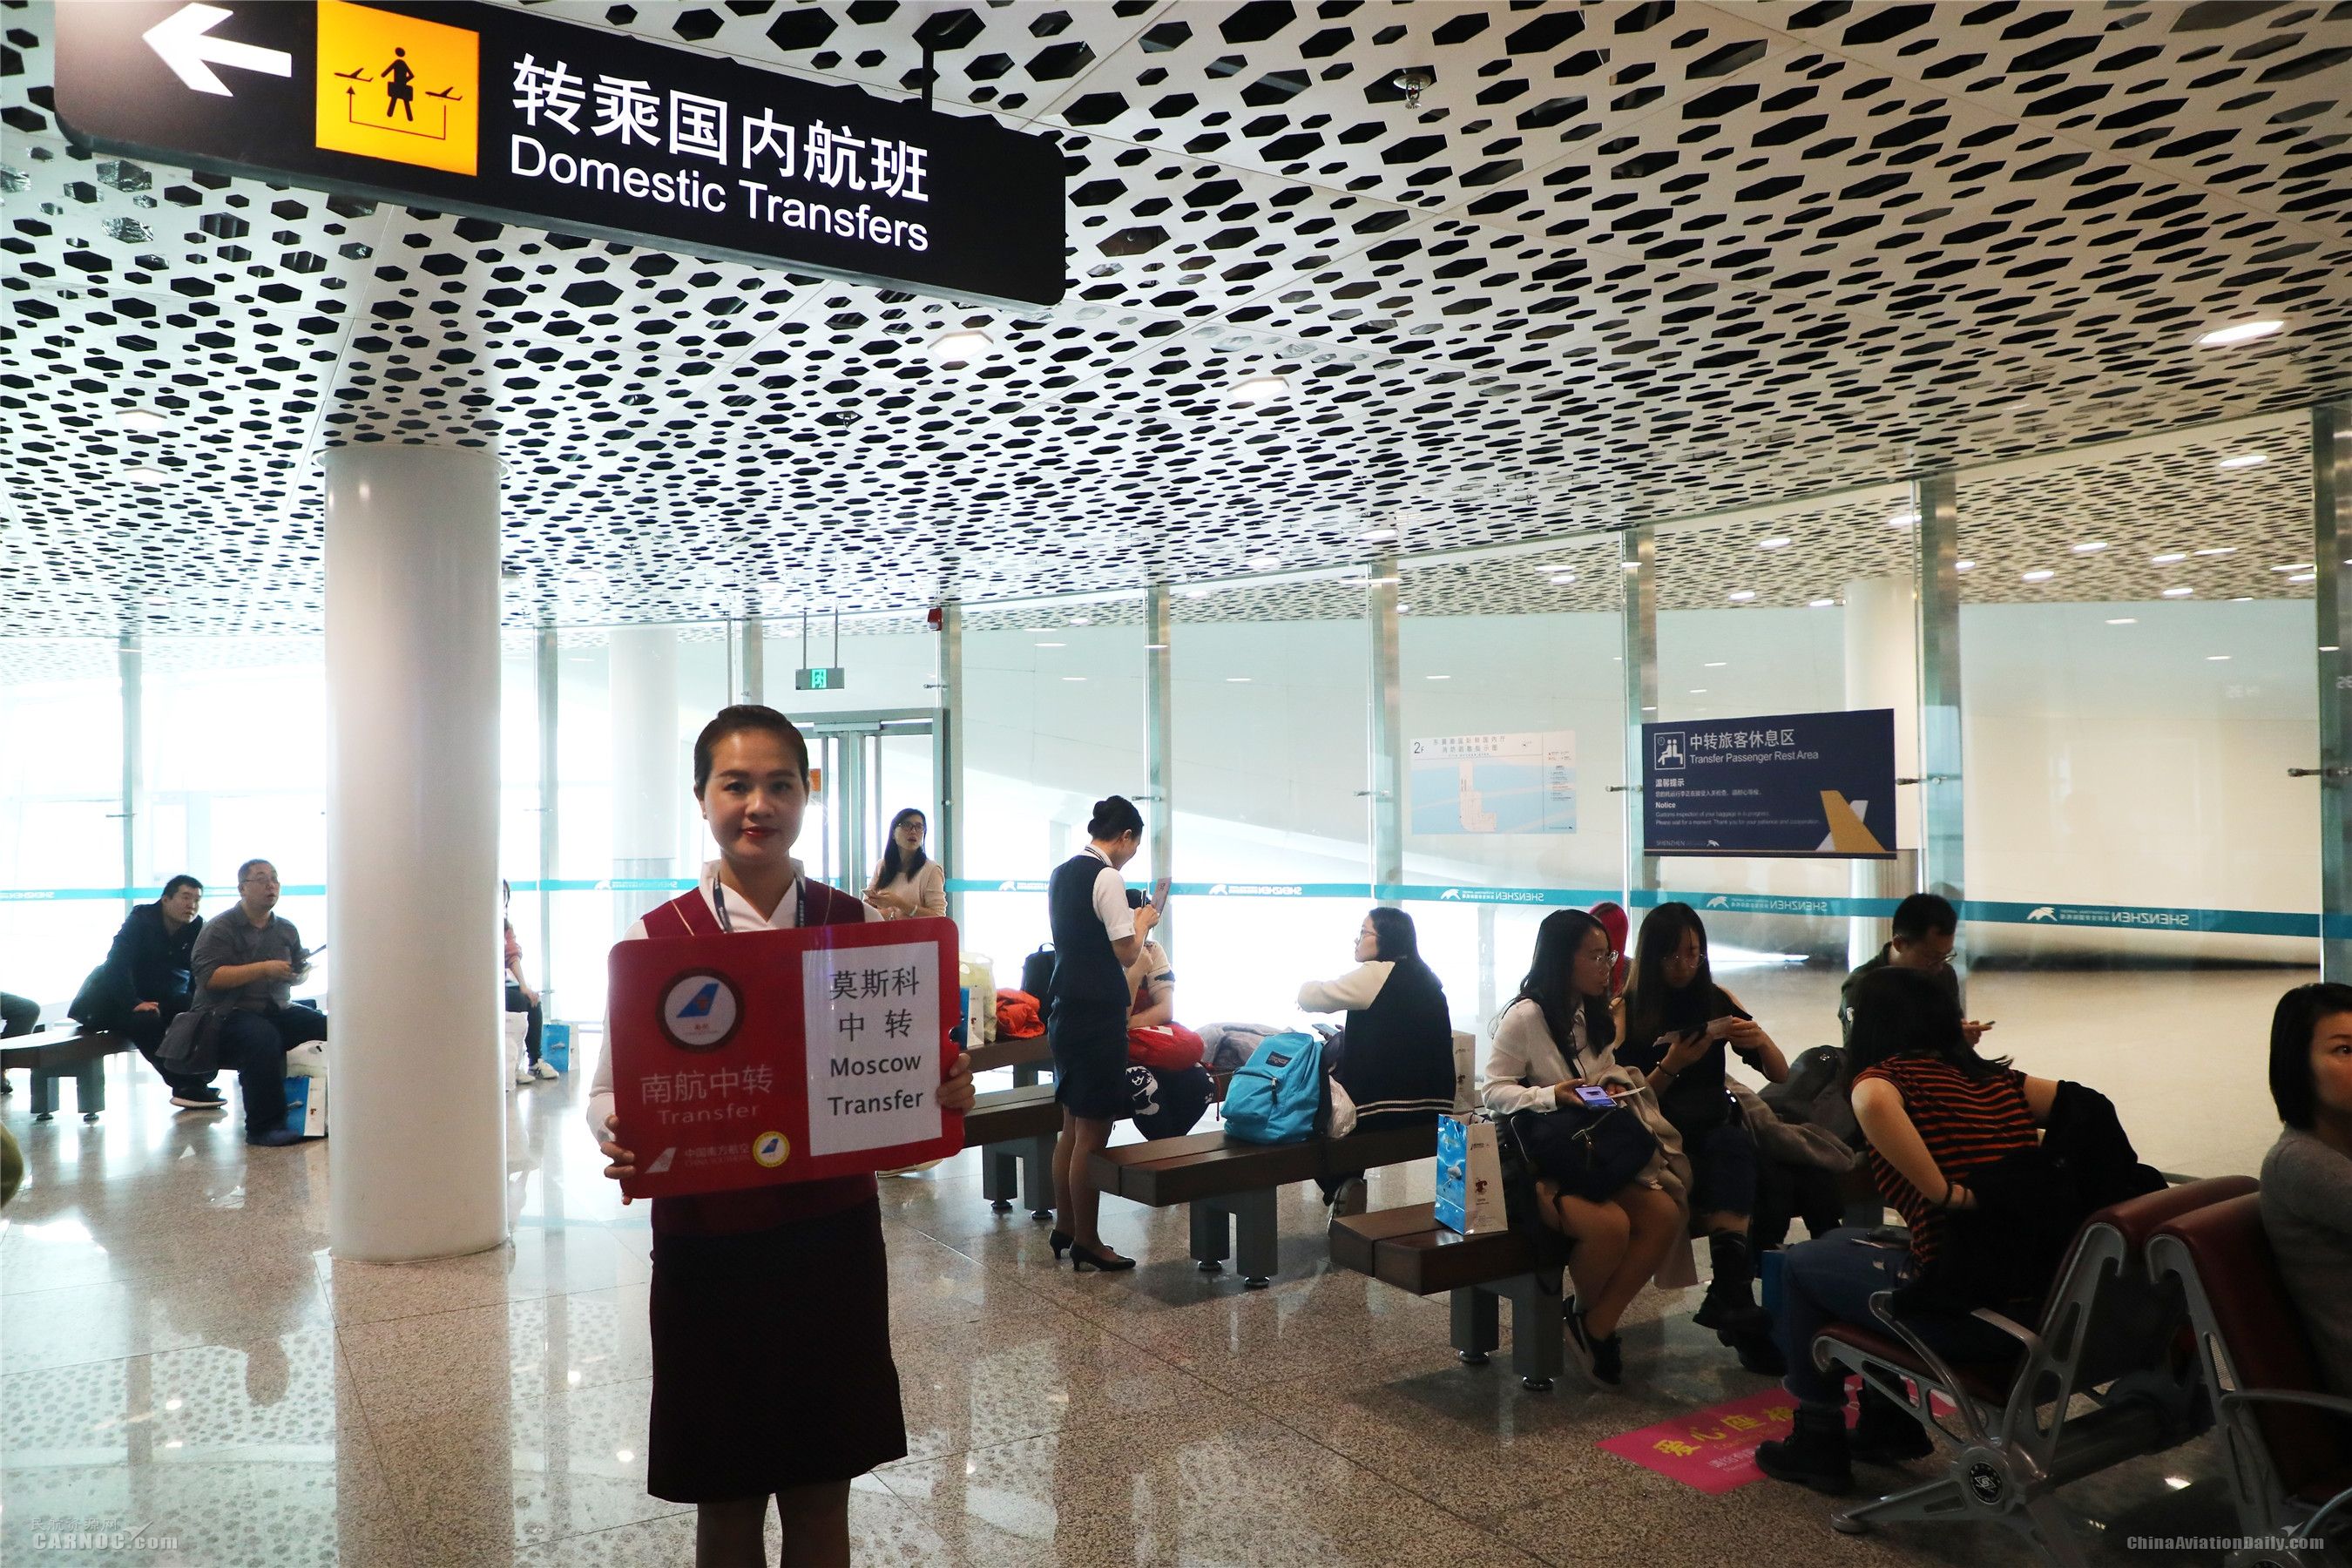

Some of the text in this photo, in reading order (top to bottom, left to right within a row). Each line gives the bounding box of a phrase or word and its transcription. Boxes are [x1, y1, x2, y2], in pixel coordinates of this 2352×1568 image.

[512, 52, 929, 202] 转乘国内航班
[510, 133, 929, 251] Domestic Transfers
[1690, 729, 1795, 751] 中转旅客休息区
[1690, 750, 1819, 765] Transfer Passenger Rest Area
[829, 966, 920, 1001] 莫斯科
[830, 1055, 922, 1078] Moscow
[640, 1064, 774, 1105] 南航中转
[658, 1103, 760, 1125] Transfer
[828, 1090, 923, 1116] Transfer
